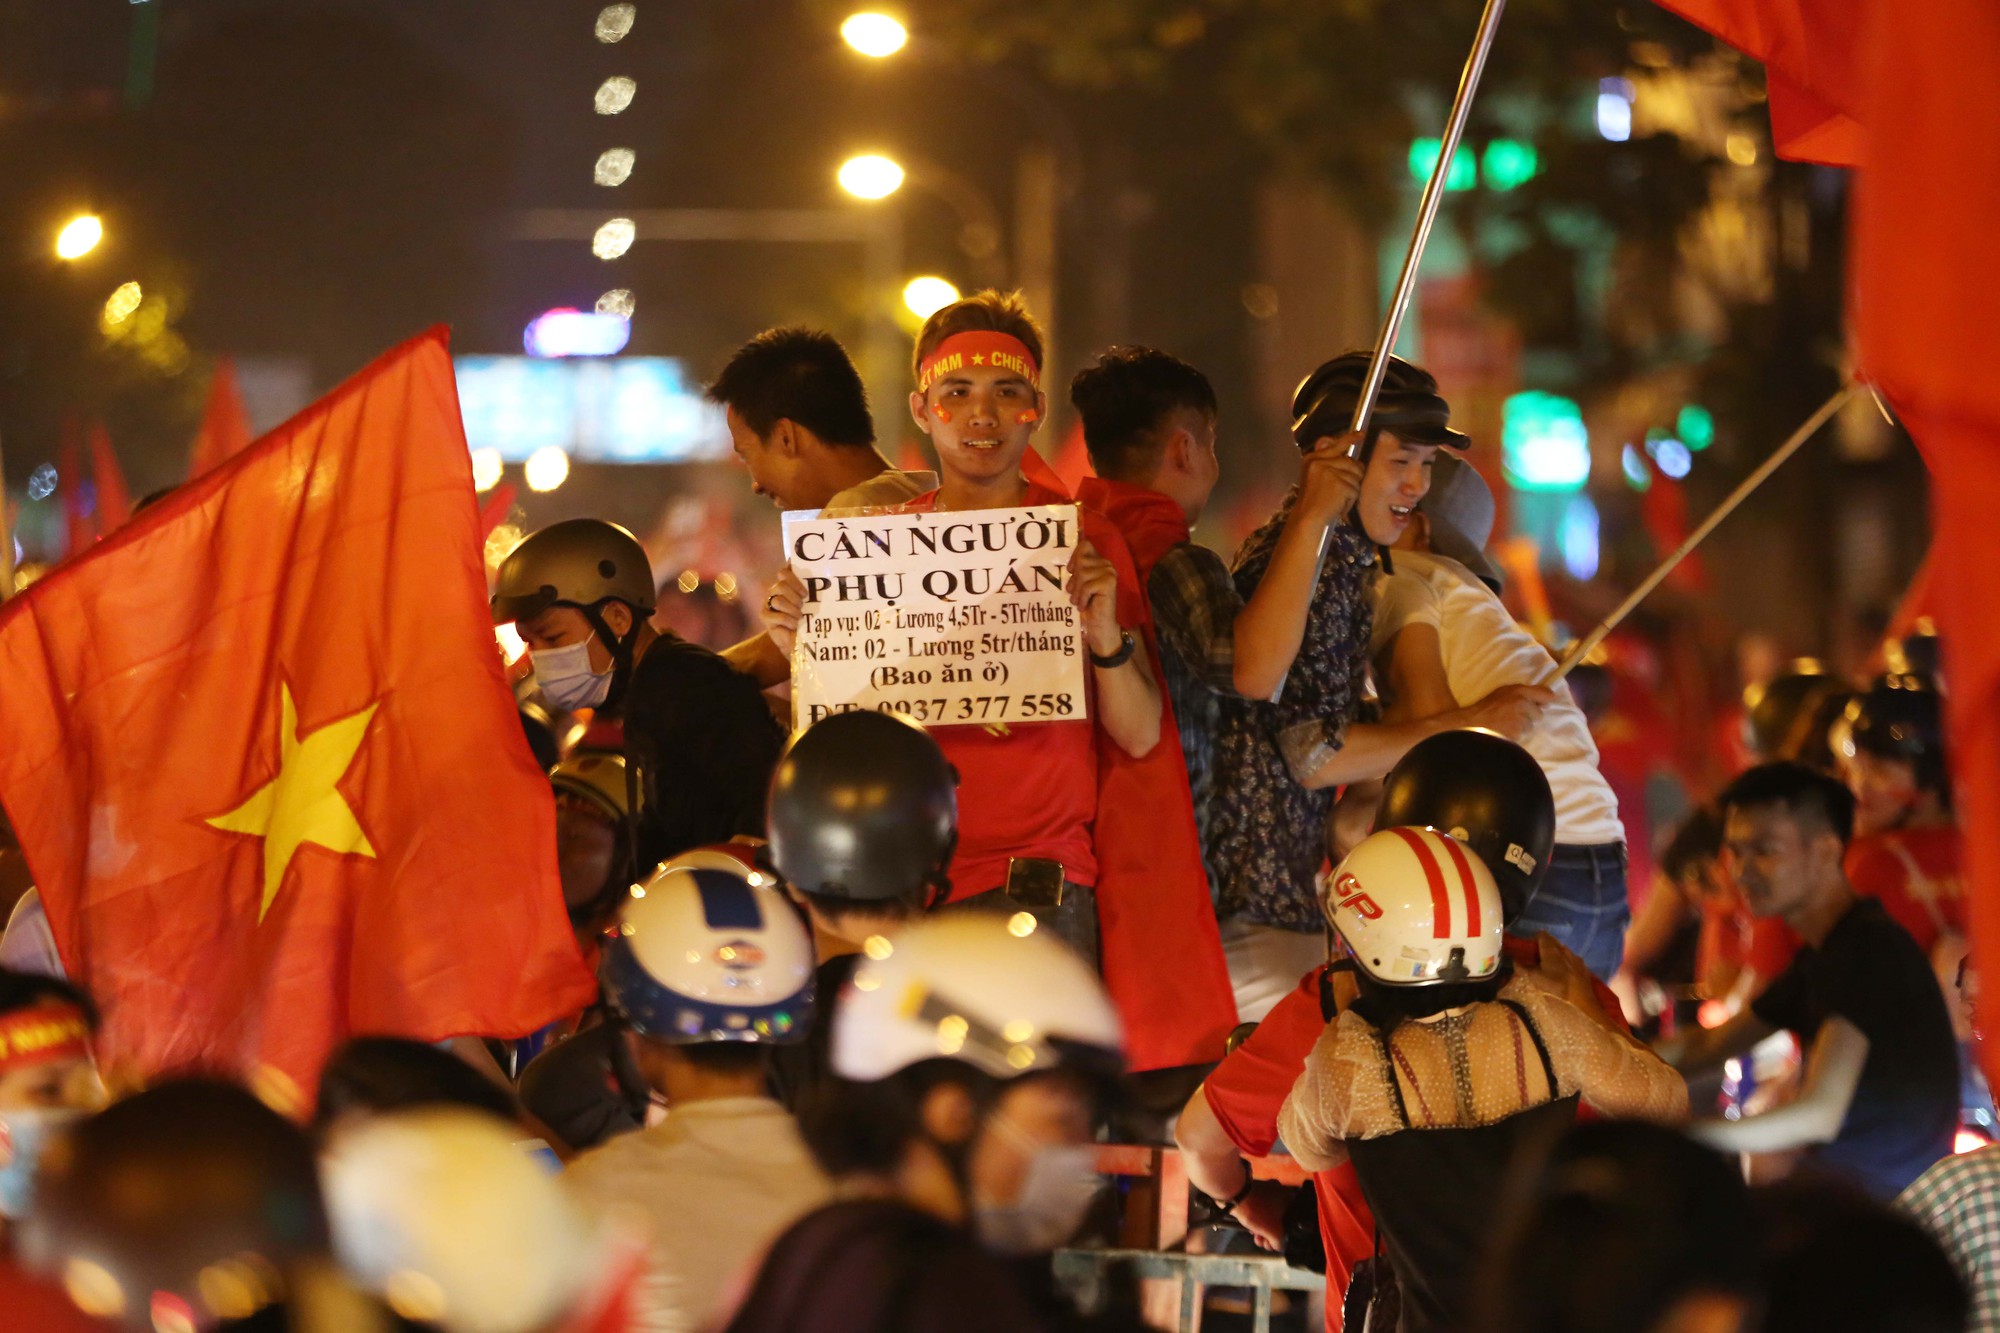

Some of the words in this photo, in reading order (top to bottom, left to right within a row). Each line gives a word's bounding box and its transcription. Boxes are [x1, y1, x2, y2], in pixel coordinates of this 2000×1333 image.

[934, 353, 963, 379] NAM
[794, 522, 893, 562] CẦN
[906, 512, 1070, 556] NGƯỜI
[802, 573, 907, 607] PHỤ
[922, 558, 1067, 602] QUÁN
[802, 613, 832, 639] Tạp
[836, 617, 860, 637] vụ:
[864, 610, 881, 631] 02
[896, 608, 944, 633] Lương
[948, 605, 987, 630] 4,5Tr
[1001, 601, 1074, 627] 5Tr/tháng
[802, 641, 857, 662] Nam:
[864, 638, 886, 660] 02
[907, 636, 975, 661] Lương
[981, 630, 1075, 656] 5tr/tháng
[870, 666, 932, 691] (Bao
[941, 662, 973, 683] ăn
[982, 661, 1009, 686] ở)
[957, 696, 1010, 719] 377
[1021, 693, 1073, 717] 558
[1335, 872, 1384, 920] GP
